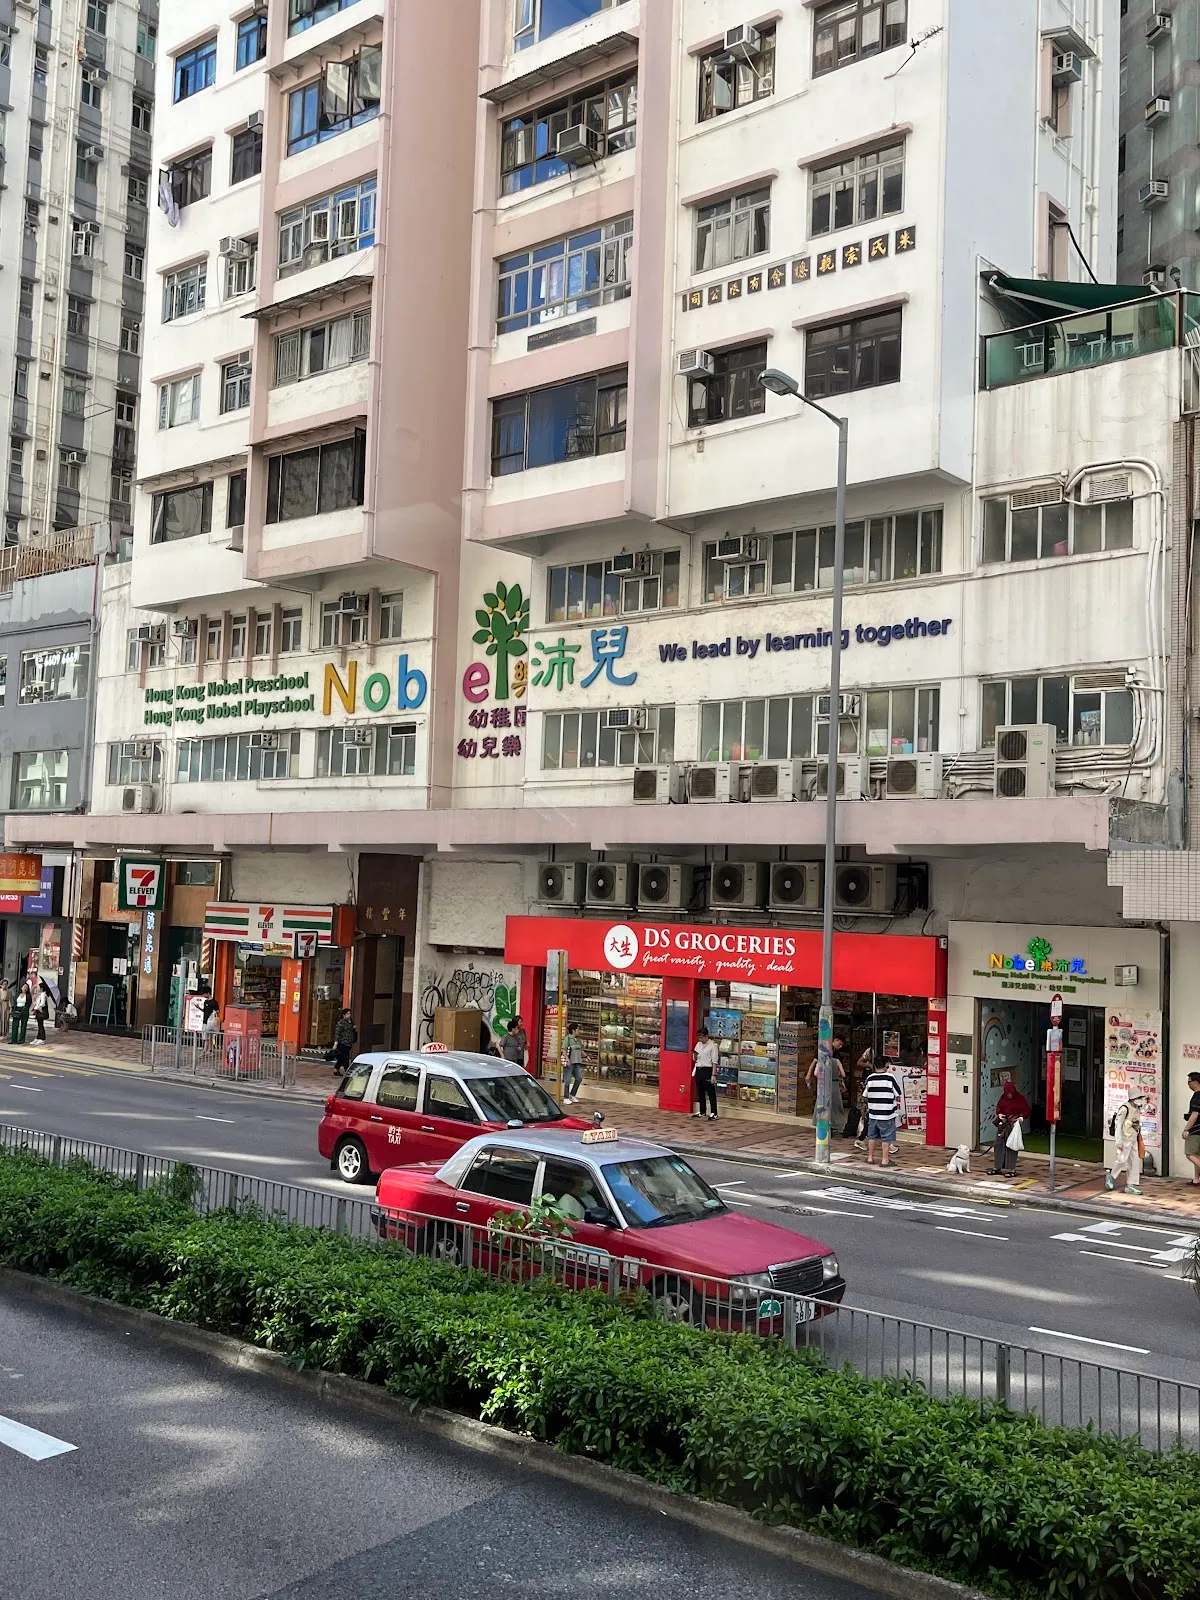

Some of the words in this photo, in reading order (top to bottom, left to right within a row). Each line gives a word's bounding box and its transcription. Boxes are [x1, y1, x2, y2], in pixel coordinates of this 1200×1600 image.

[659, 643, 687, 662] We
[692, 637, 731, 658] lead
[735, 636, 760, 658] by
[765, 627, 850, 652] learning
[855, 617, 952, 646] together
[144, 688, 174, 704] Hong
[175, 685, 206, 702] Kong
[207, 679, 243, 696] Nobel
[244, 671, 309, 693] Preschool
[143, 710, 172, 727] Hong
[174, 707, 205, 725] Kong
[206, 700, 242, 719] Nobel
[243, 694, 315, 718] Playschool
[610, 936, 633, 958] 大生
[643, 928, 671, 948] DS
[674, 932, 796, 956] GROCERIES
[642, 951, 671, 967] Great
[670, 955, 706, 973] variety
[716, 957, 756, 977] quality
[766, 959, 794, 973] deals
[388, 1134, 402, 1145] TAXI
[591, 1130, 616, 1141] TAXI
